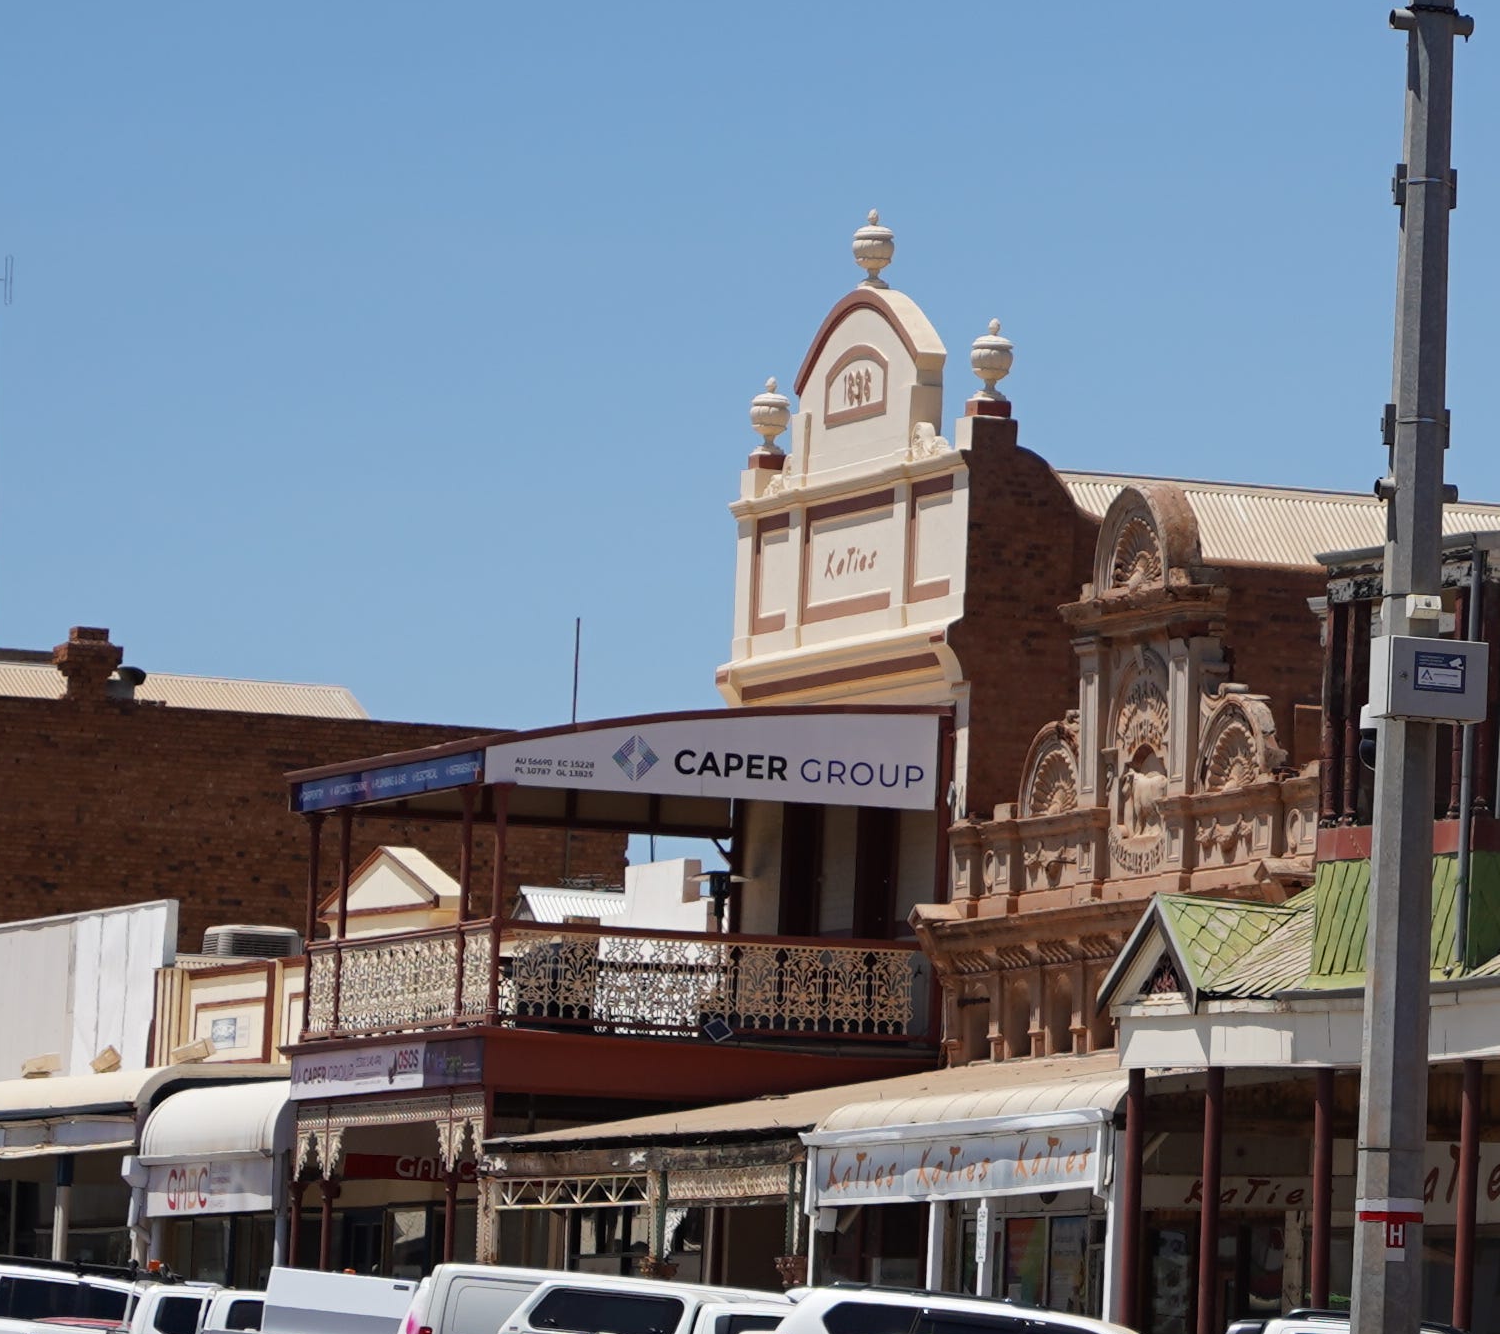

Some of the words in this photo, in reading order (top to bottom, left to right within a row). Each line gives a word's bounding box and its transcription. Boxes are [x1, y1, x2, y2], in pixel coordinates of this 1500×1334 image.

[515, 766, 525, 774] PL
[557, 760, 570, 768] EC
[674, 748, 789, 781] CAPER
[800, 758, 925, 789] GROUP
[395, 1155, 476, 1181] GAC
[1184, 1178, 1305, 1206] KaTie
[1390, 1223, 1404, 1246] H
